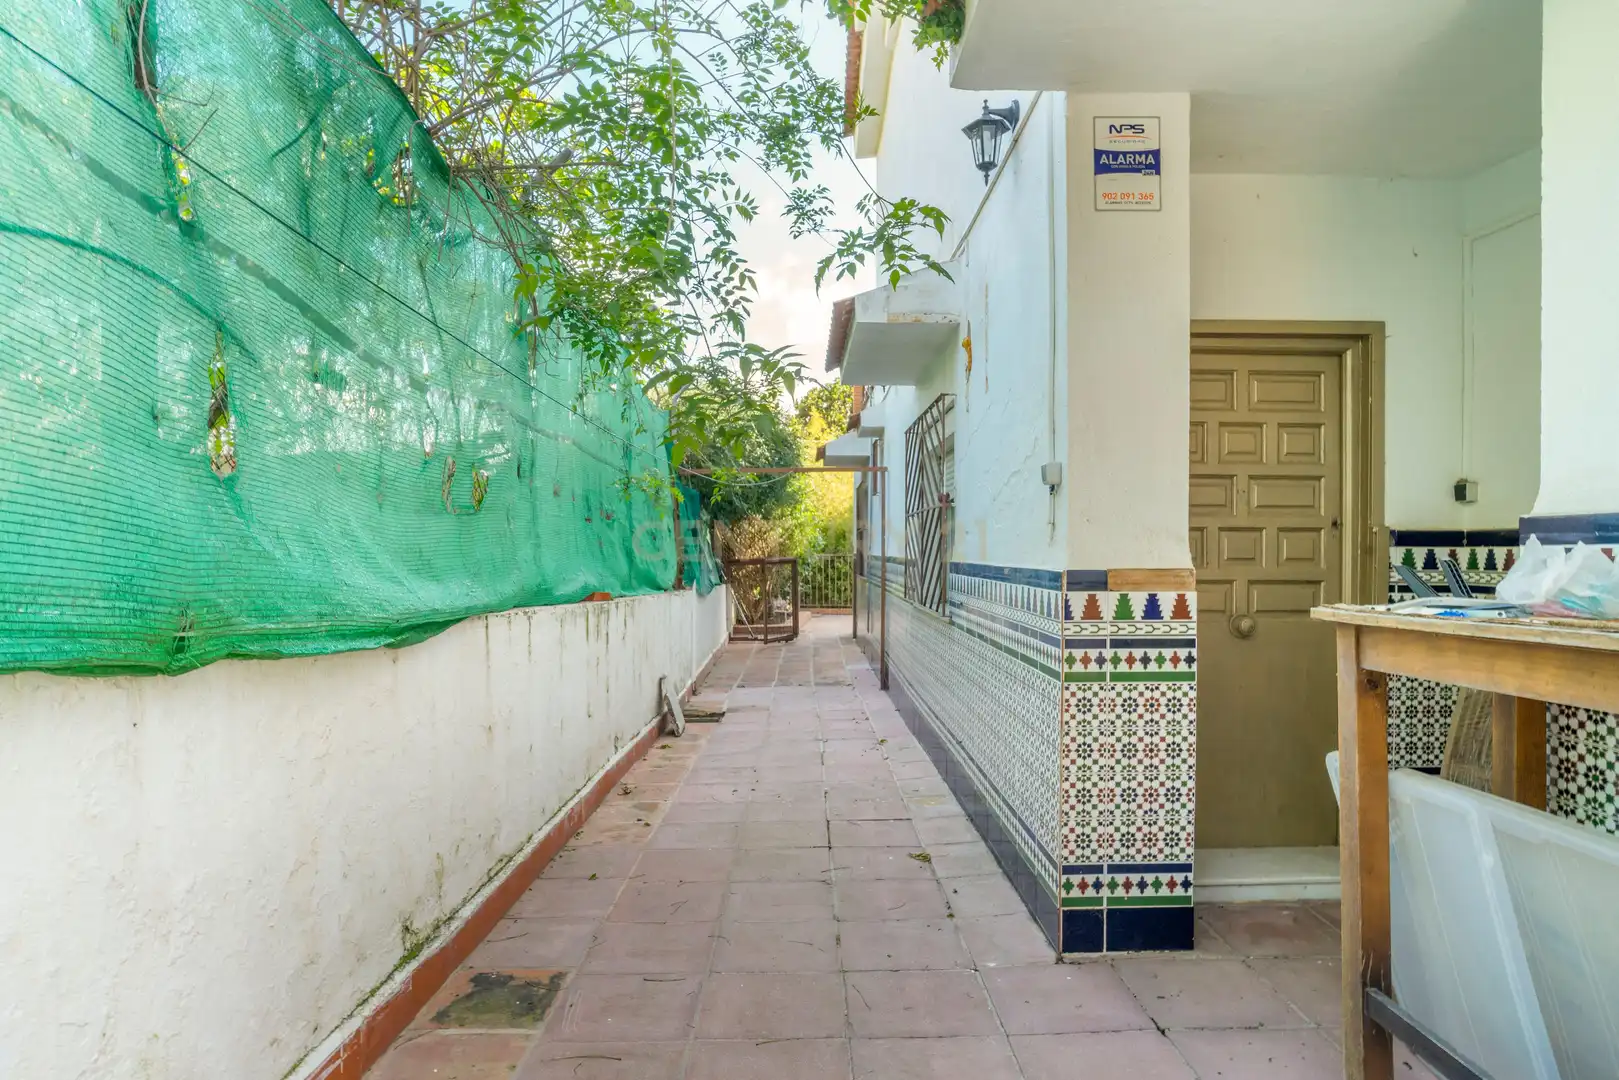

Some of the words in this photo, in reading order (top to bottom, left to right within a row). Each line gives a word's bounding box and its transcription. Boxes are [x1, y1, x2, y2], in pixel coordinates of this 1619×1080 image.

[1109, 124, 1145, 134] NPS
[1100, 153, 1155, 165] ALARMA
[1102, 192, 1118, 201] 902
[1120, 192, 1135, 201] 091
[1138, 192, 1154, 201] 365
